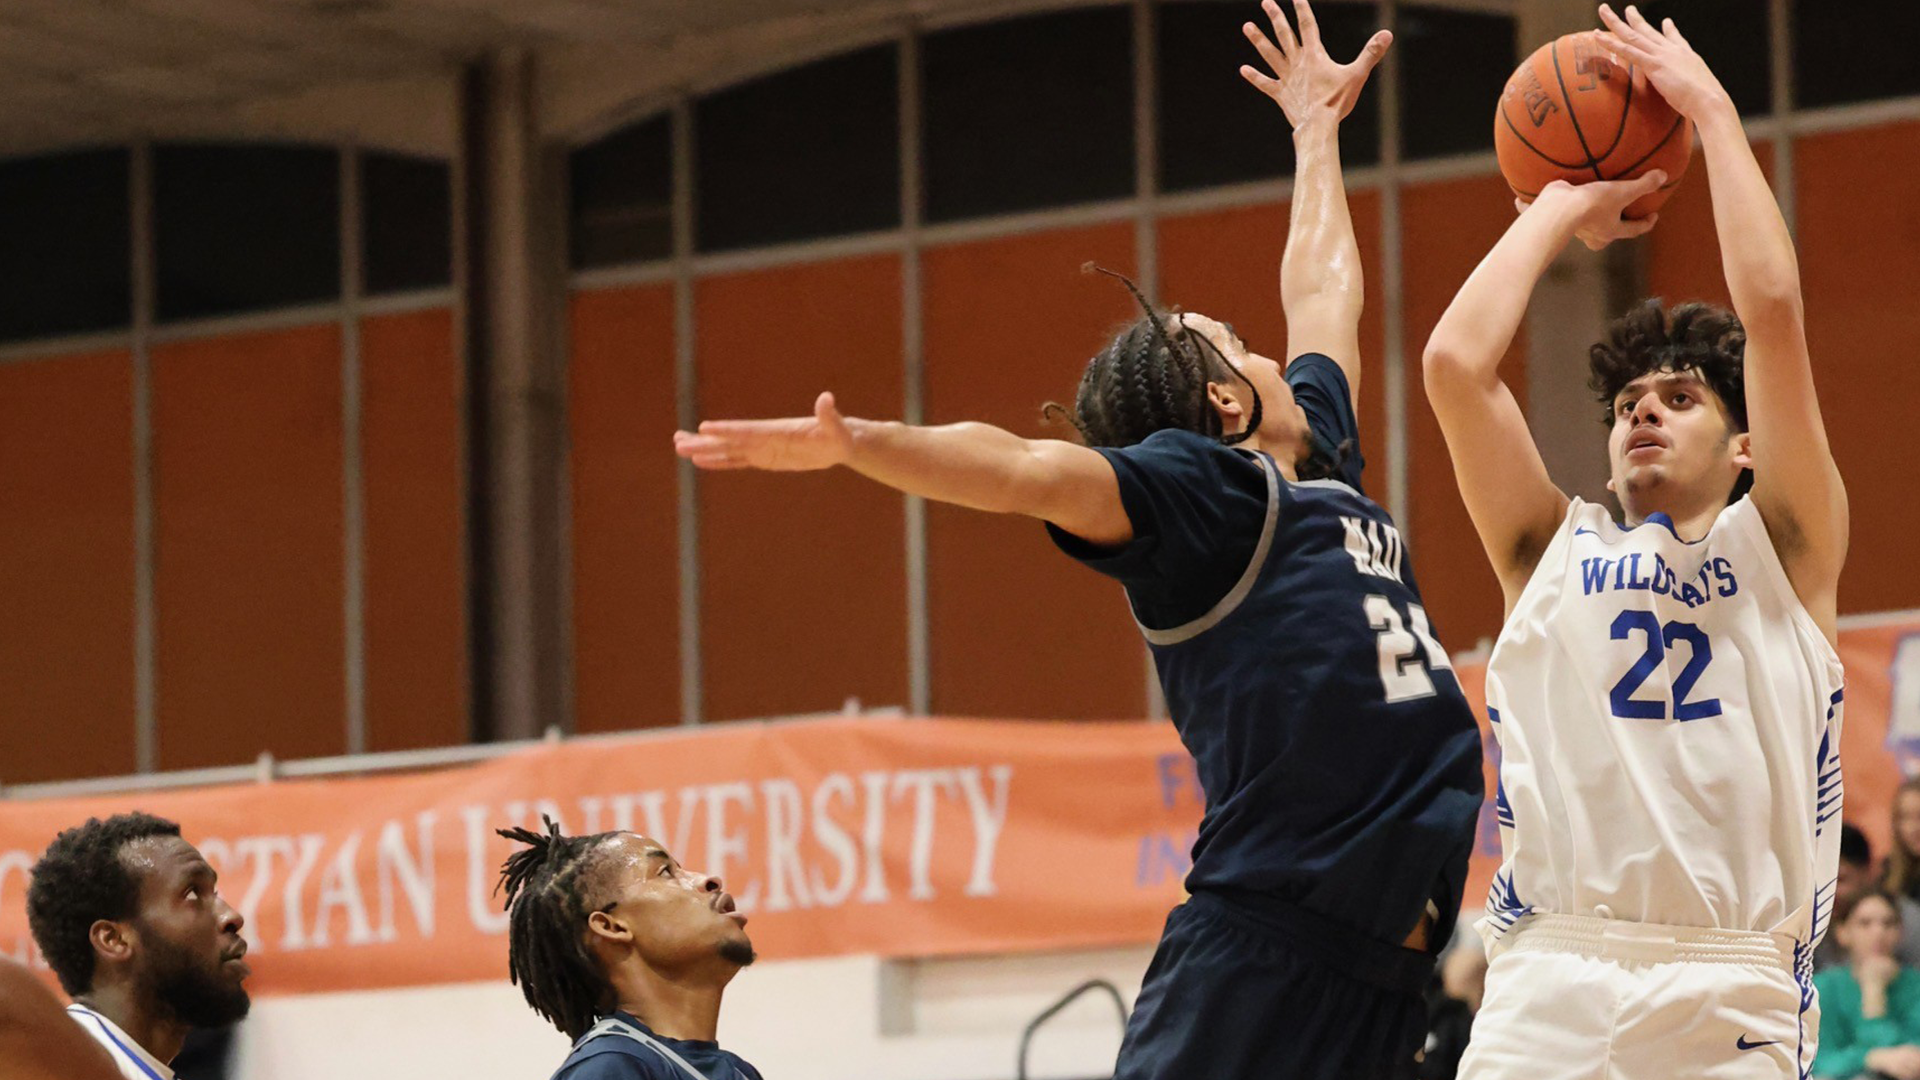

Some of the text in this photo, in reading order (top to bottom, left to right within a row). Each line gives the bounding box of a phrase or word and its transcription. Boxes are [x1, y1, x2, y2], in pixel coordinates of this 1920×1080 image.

[1581, 552, 1738, 608] WILDCATS
[1609, 608, 1722, 722] 22
[460, 765, 1012, 935] UVERSITY
